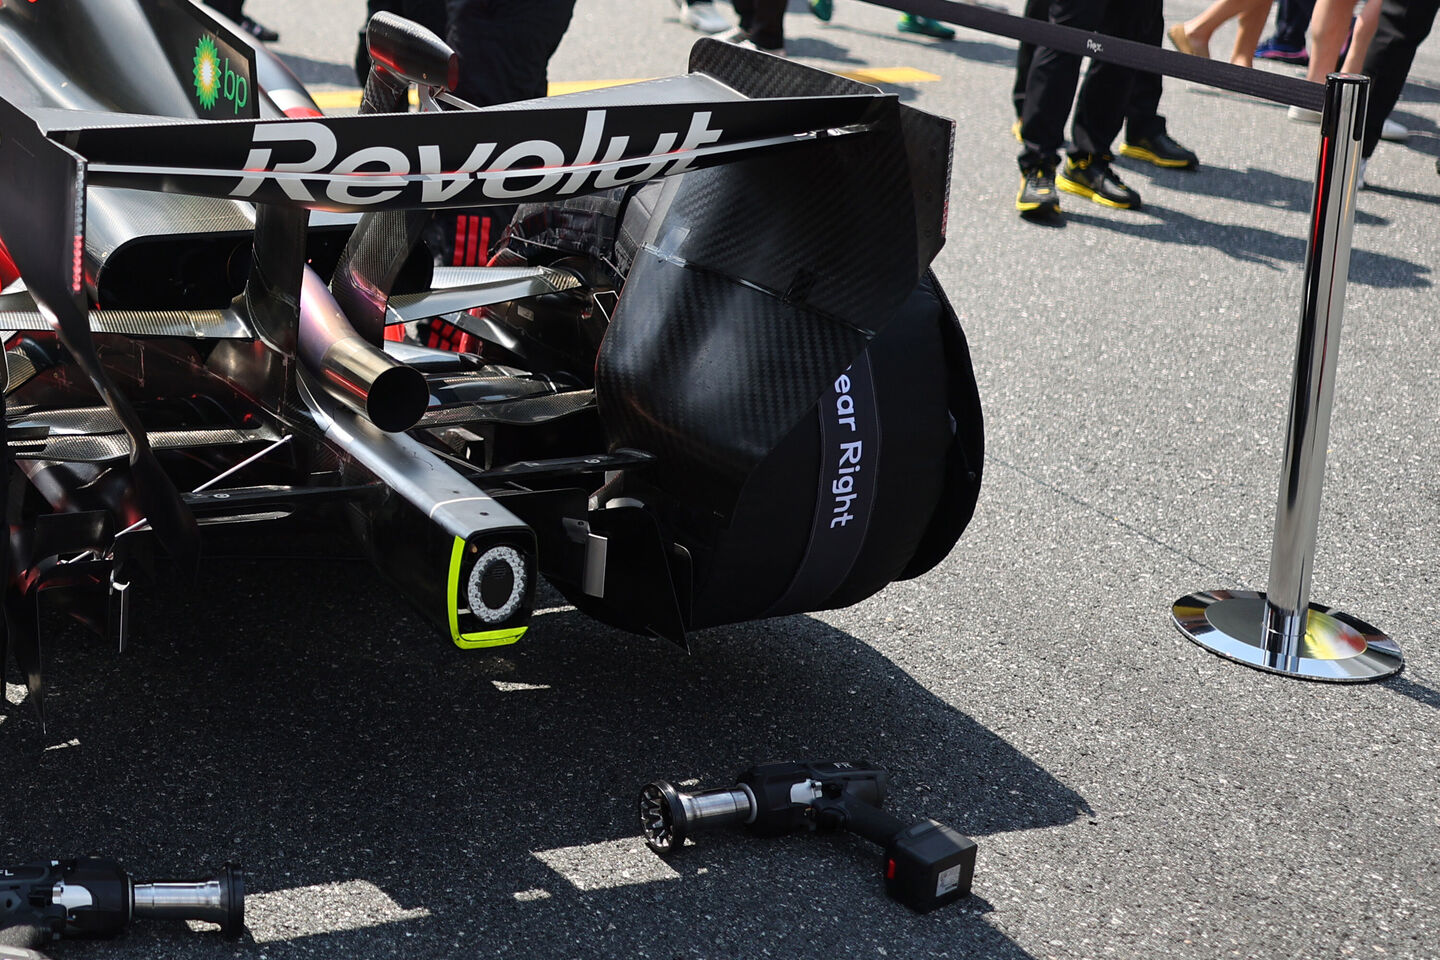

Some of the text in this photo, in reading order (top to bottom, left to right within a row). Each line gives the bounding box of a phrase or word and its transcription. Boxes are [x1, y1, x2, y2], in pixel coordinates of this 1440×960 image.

[223, 57, 248, 115] bp
[228, 109, 724, 204] Revolut
[829, 364, 863, 529] ear Right
